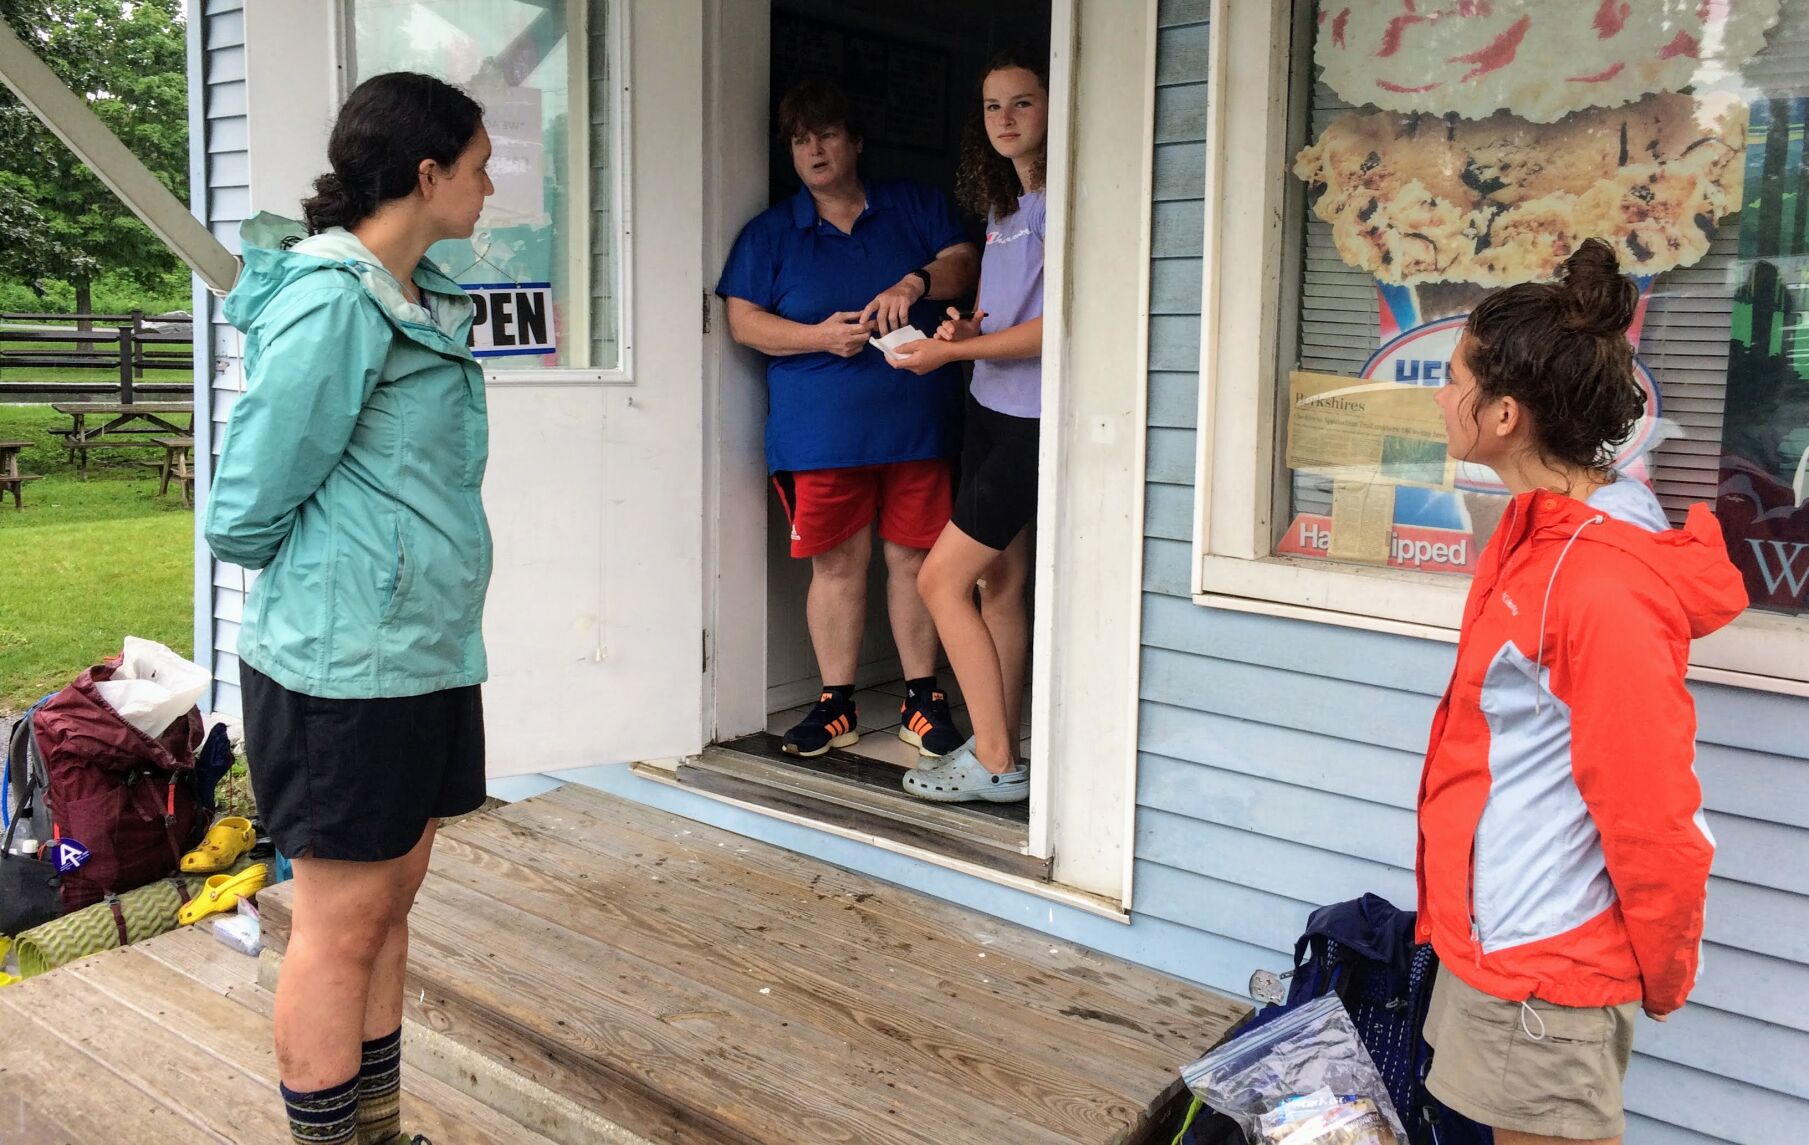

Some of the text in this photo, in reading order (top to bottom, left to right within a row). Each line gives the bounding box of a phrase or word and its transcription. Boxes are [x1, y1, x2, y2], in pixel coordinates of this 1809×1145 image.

[467, 291, 548, 347] PEN
[1395, 359, 1452, 386] HE
[1300, 522, 1468, 567] Ha ipped
